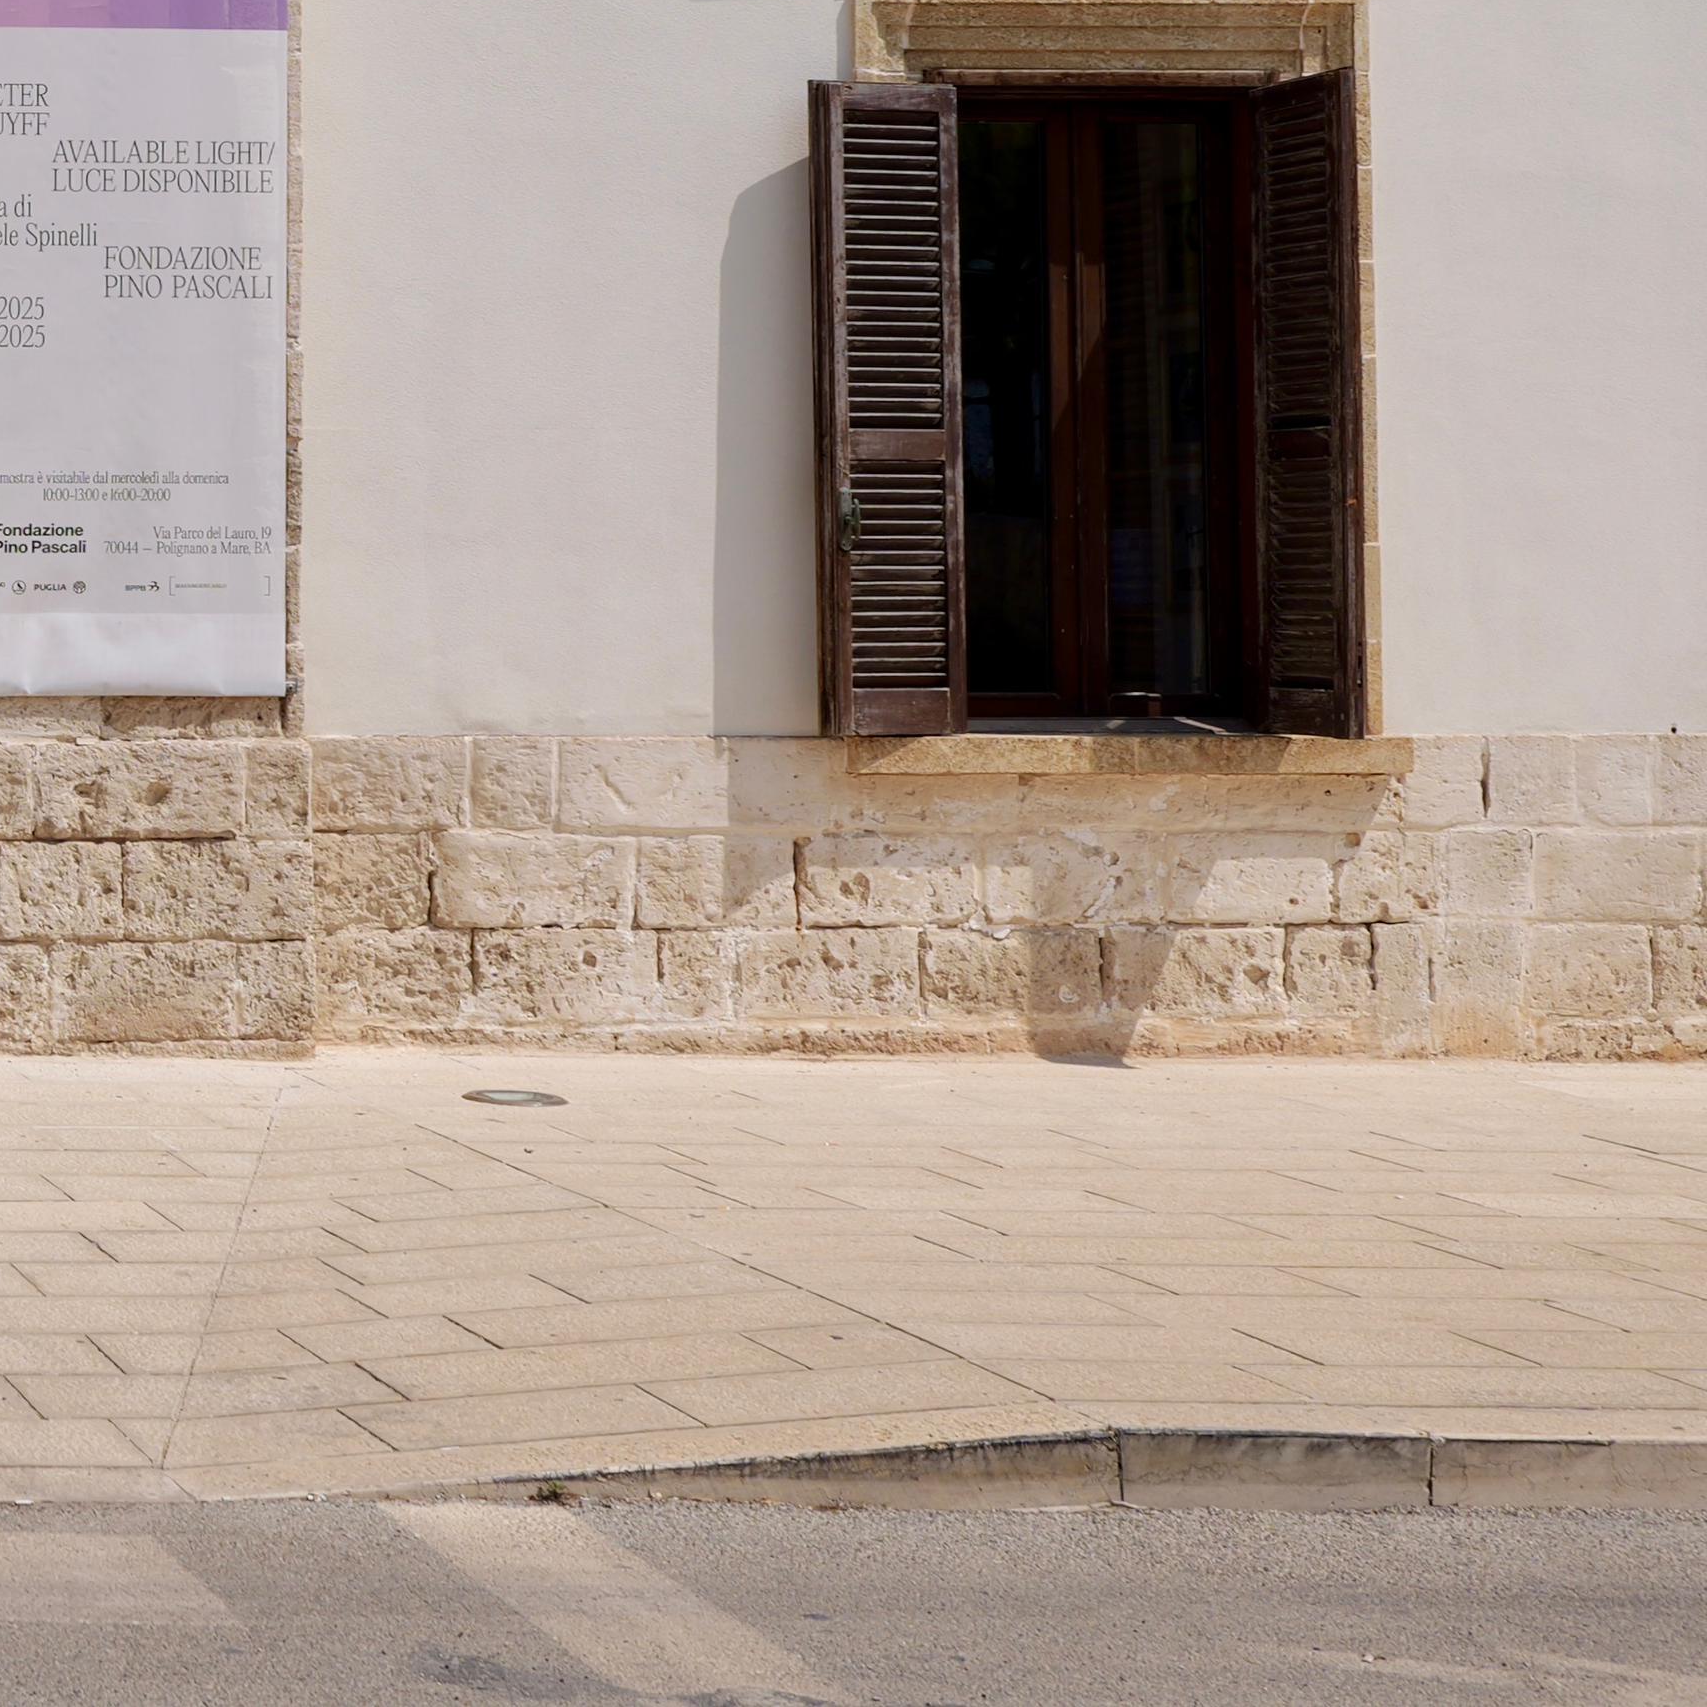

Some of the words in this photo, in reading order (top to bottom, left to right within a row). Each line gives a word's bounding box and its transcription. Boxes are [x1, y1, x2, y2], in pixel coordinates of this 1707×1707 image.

[52, 140, 190, 165] AVAILABLE
[195, 141, 275, 165] LIGHT/
[52, 169, 116, 193] LUCE
[123, 169, 274, 193] DISPONIBILE
[14, 194, 32, 217] di
[25, 222, 98, 252] Spinelli
[104, 246, 262, 270] FONDAZIONE
[103, 275, 162, 299] PINO
[171, 275, 273, 299] PASCALI
[0, 472, 35, 484] mostra
[46, 471, 91, 484] visitabile
[93, 471, 108, 484] dal
[111, 471, 160, 484] mercoledì
[162, 471, 180, 484] alla
[182, 471, 229, 484] domenica
[101, 491, 108, 501] e
[153, 526, 171, 539] Via
[174, 526, 204, 539] Parco
[206, 526, 221, 539] del
[261, 526, 272, 539] 19
[32, 540, 87, 553] Pascali
[104, 540, 139, 554] 70044
[156, 540, 209, 557] Polignano
[211, 544, 217, 554] a
[220, 541, 251, 556] Mare,
[254, 541, 272, 554] BA
